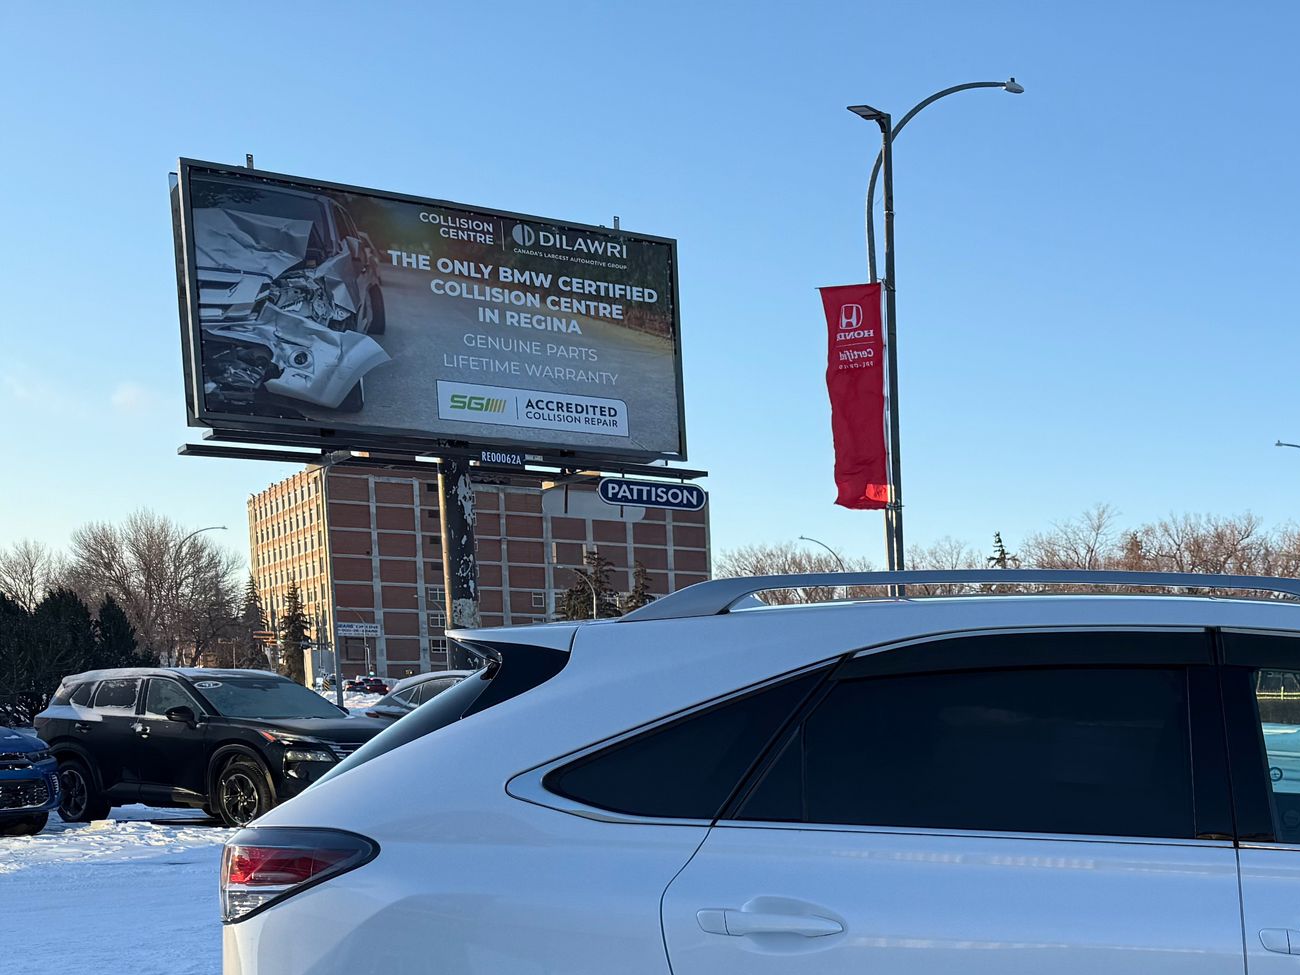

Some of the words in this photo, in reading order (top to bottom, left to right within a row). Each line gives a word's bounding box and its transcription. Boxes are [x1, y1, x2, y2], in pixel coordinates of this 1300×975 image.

[419, 212, 494, 233] COLLISION
[439, 227, 494, 245] CENTRE
[539, 231, 627, 259] DILAWRI
[513, 248, 543, 257] CANADA'S
[544, 252, 569, 261] LARGEST
[570, 257, 606, 267] AUTOMOTIVE
[607, 262, 628, 270] GROUP
[387, 249, 431, 272] THE
[437, 257, 493, 280] ONLY
[499, 267, 552, 289] BMW
[558, 276, 659, 303] CERTIFIED
[430, 279, 541, 309] COLLISION
[546, 295, 623, 320] CENTRE
[478, 306, 498, 325] IN
[505, 309, 583, 336] REGINA
[463, 333, 542, 355] GENUINE
[546, 345, 598, 362] PARTS
[443, 353, 521, 375] LIFETIME
[525, 364, 619, 385] WARRANTY
[449, 394, 496, 413] SGI
[525, 398, 618, 418] ACCREDITED
[525, 411, 582, 424] COLLISION
[584, 416, 618, 428] REPAIR
[481, 451, 522, 465] RE00062A
[607, 482, 698, 506] PATTISON
